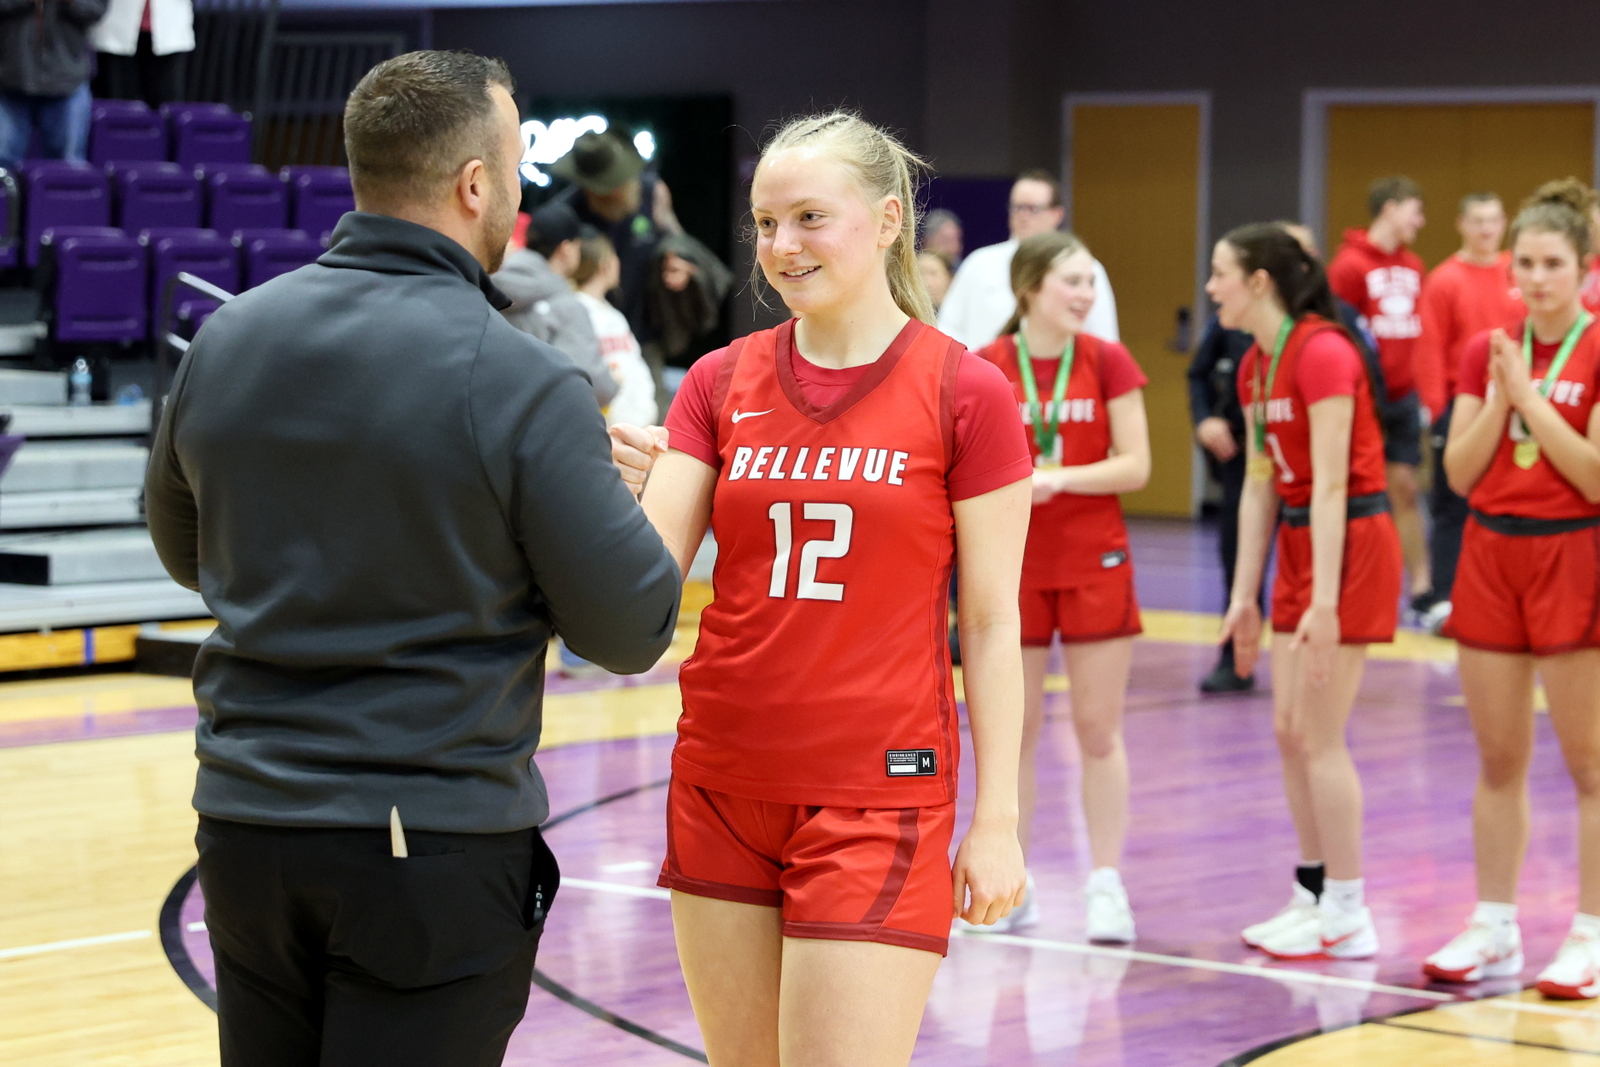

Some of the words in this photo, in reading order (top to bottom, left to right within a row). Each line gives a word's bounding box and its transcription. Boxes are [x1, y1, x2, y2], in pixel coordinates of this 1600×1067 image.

[727, 445, 910, 487] BELLEVUE
[767, 501, 854, 602] 12
[922, 757, 930, 768] M
